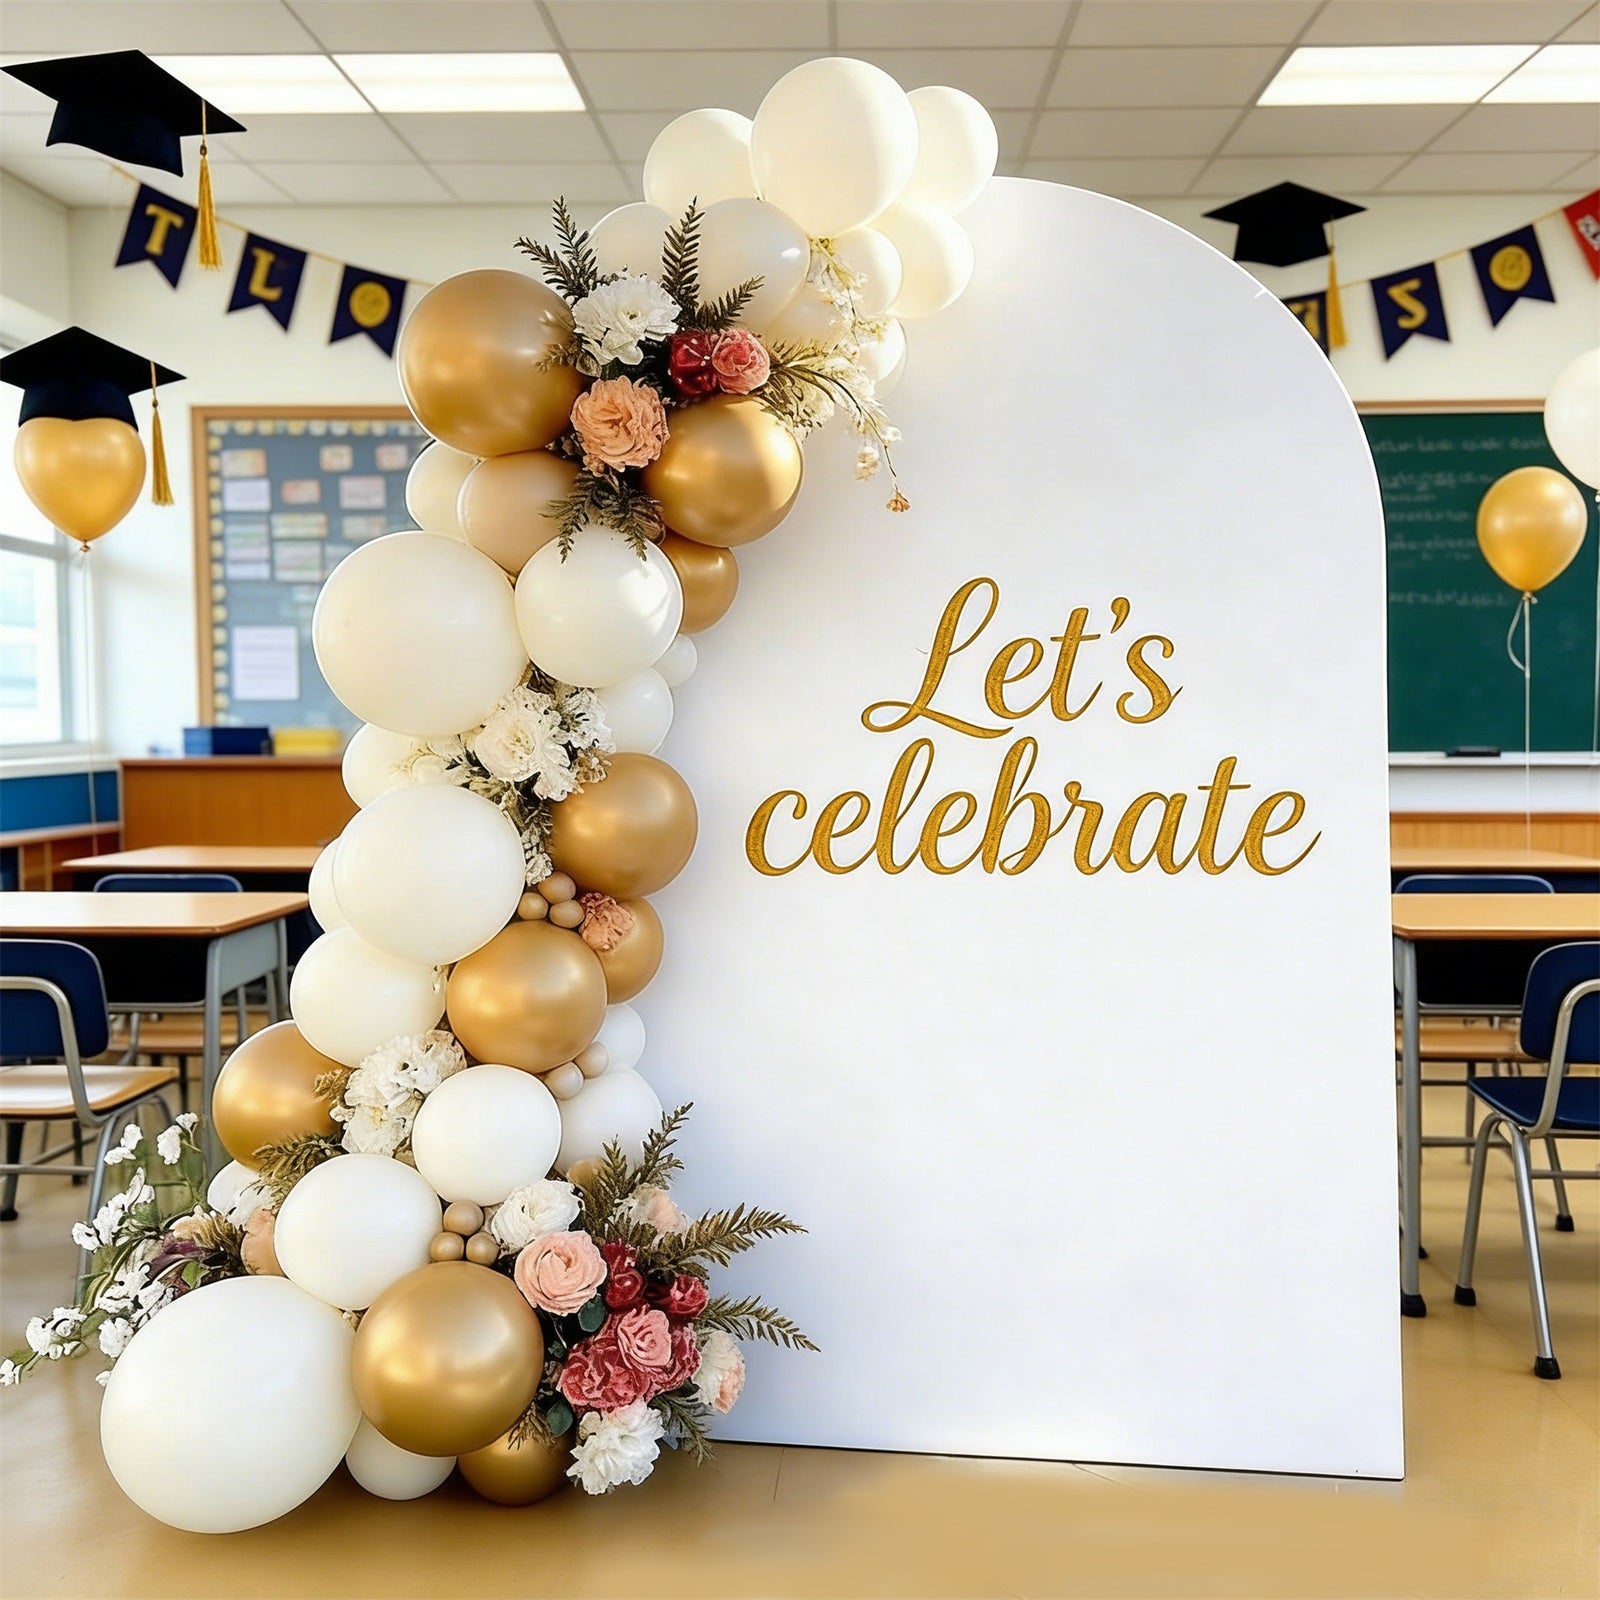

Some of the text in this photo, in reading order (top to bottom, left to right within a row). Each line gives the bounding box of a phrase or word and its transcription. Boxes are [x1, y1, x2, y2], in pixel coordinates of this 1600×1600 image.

[144, 202, 185, 257] T
[861, 577, 1183, 738] Let's
[745, 736, 1322, 876] celebrate
